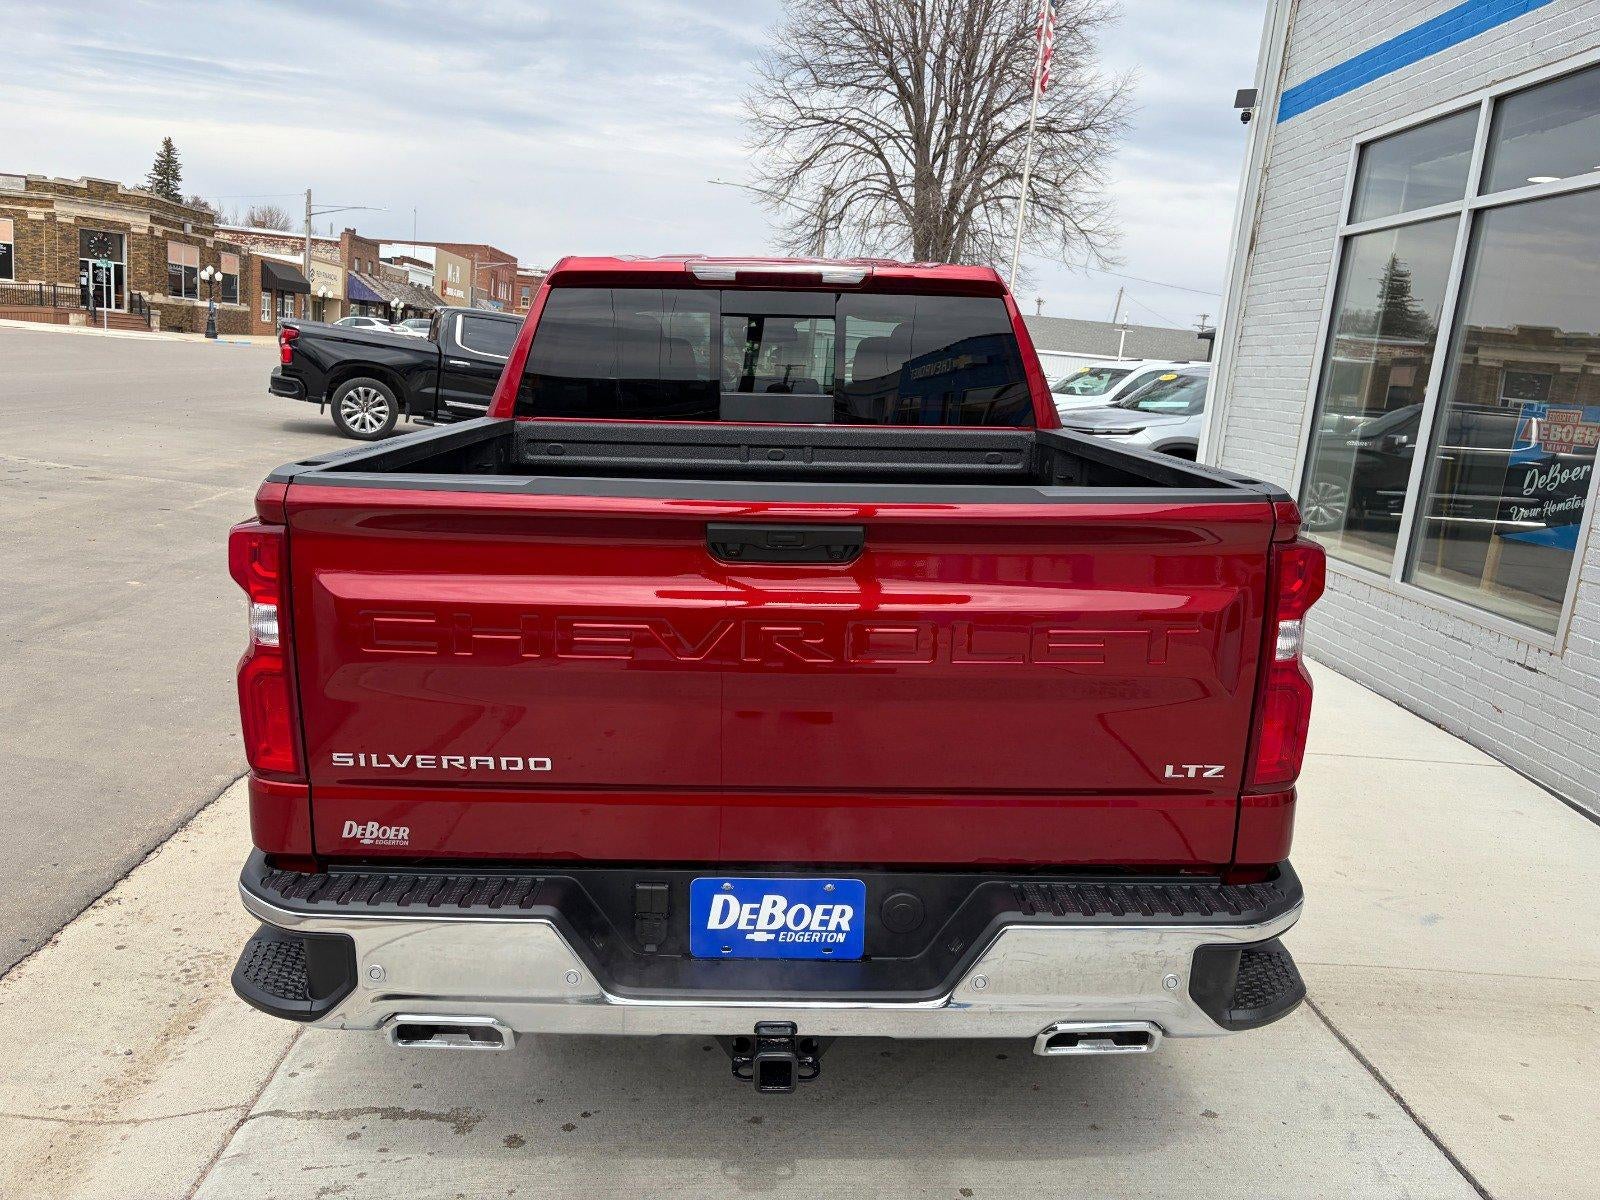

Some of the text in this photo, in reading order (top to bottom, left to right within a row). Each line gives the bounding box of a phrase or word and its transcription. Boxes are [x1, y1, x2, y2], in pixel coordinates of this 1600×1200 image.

[1549, 412, 1579, 422] EDGERTON
[1523, 463, 1591, 496] DeBoer
[1510, 505, 1541, 521] Your
[359, 610, 1200, 664] CHEVROLET
[332, 753, 552, 771] SILVERADO
[1165, 764, 1226, 778] LTZ
[778, 931, 846, 943] EDGERTON
